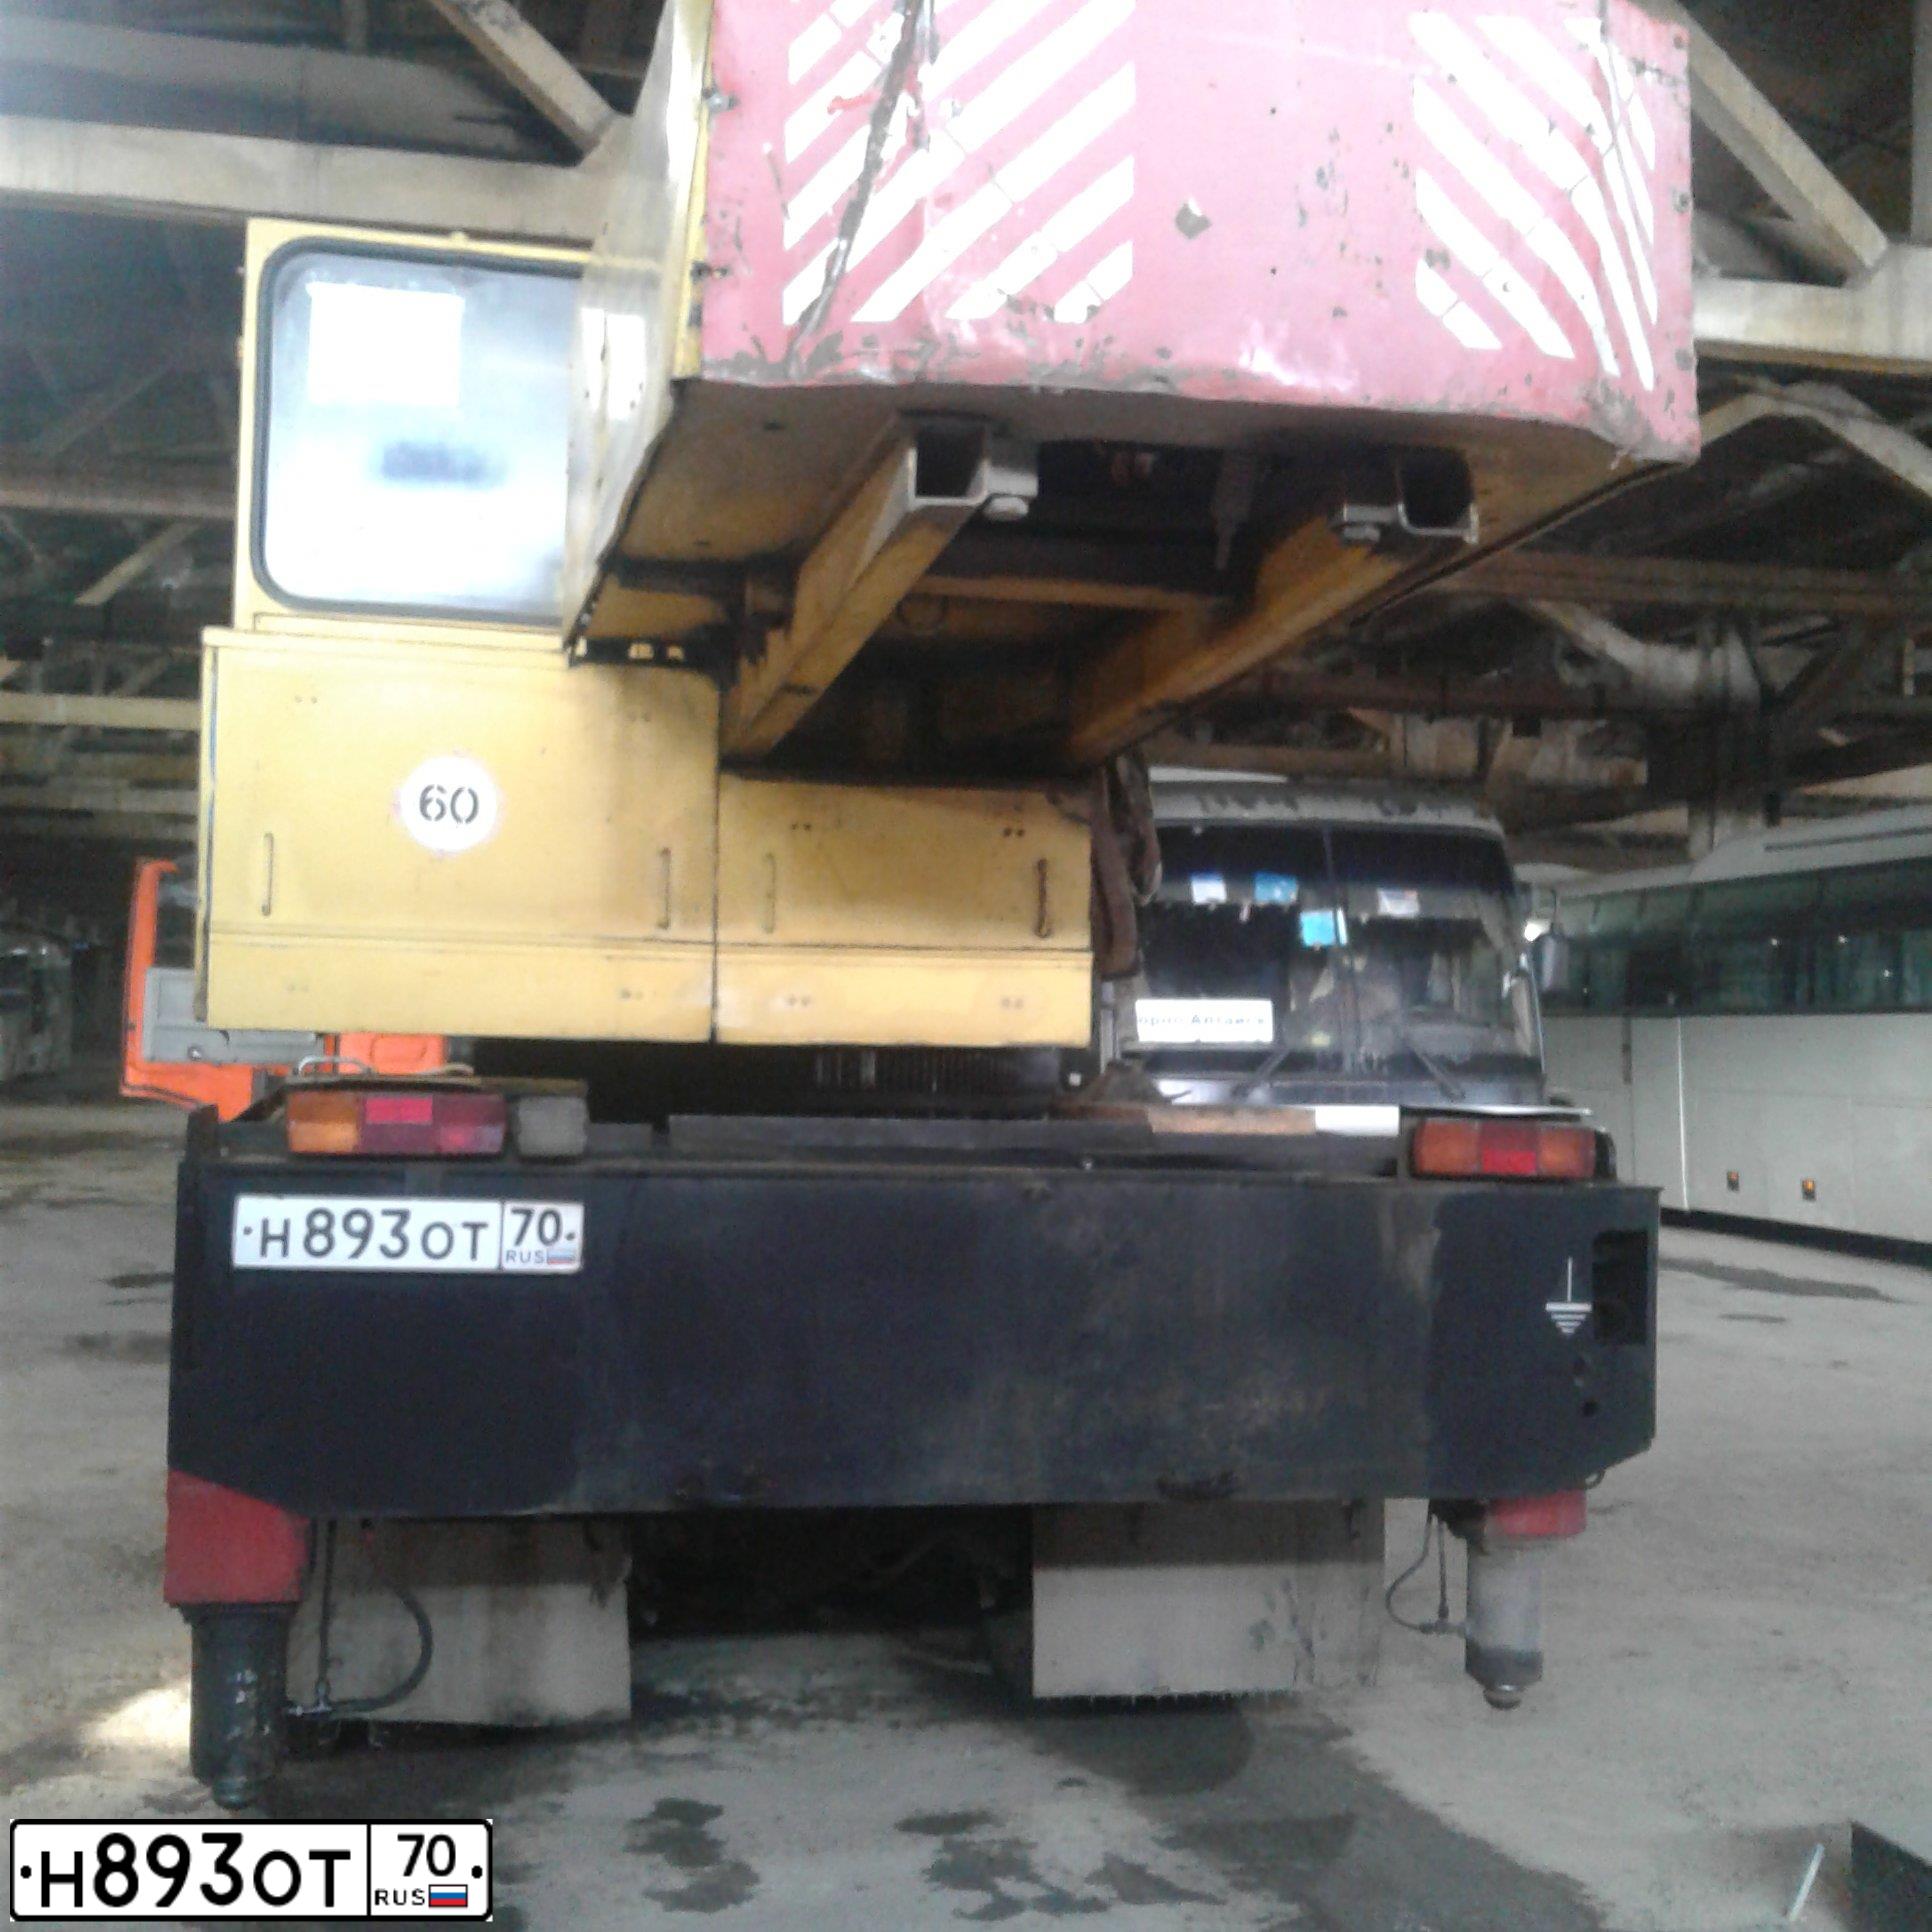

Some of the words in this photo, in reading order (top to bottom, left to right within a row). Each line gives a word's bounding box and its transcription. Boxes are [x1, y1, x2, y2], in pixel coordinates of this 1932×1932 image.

[419, 784, 479, 824] 60
[509, 1207, 563, 1247] 70
[505, 1250, 544, 1265] RUS
